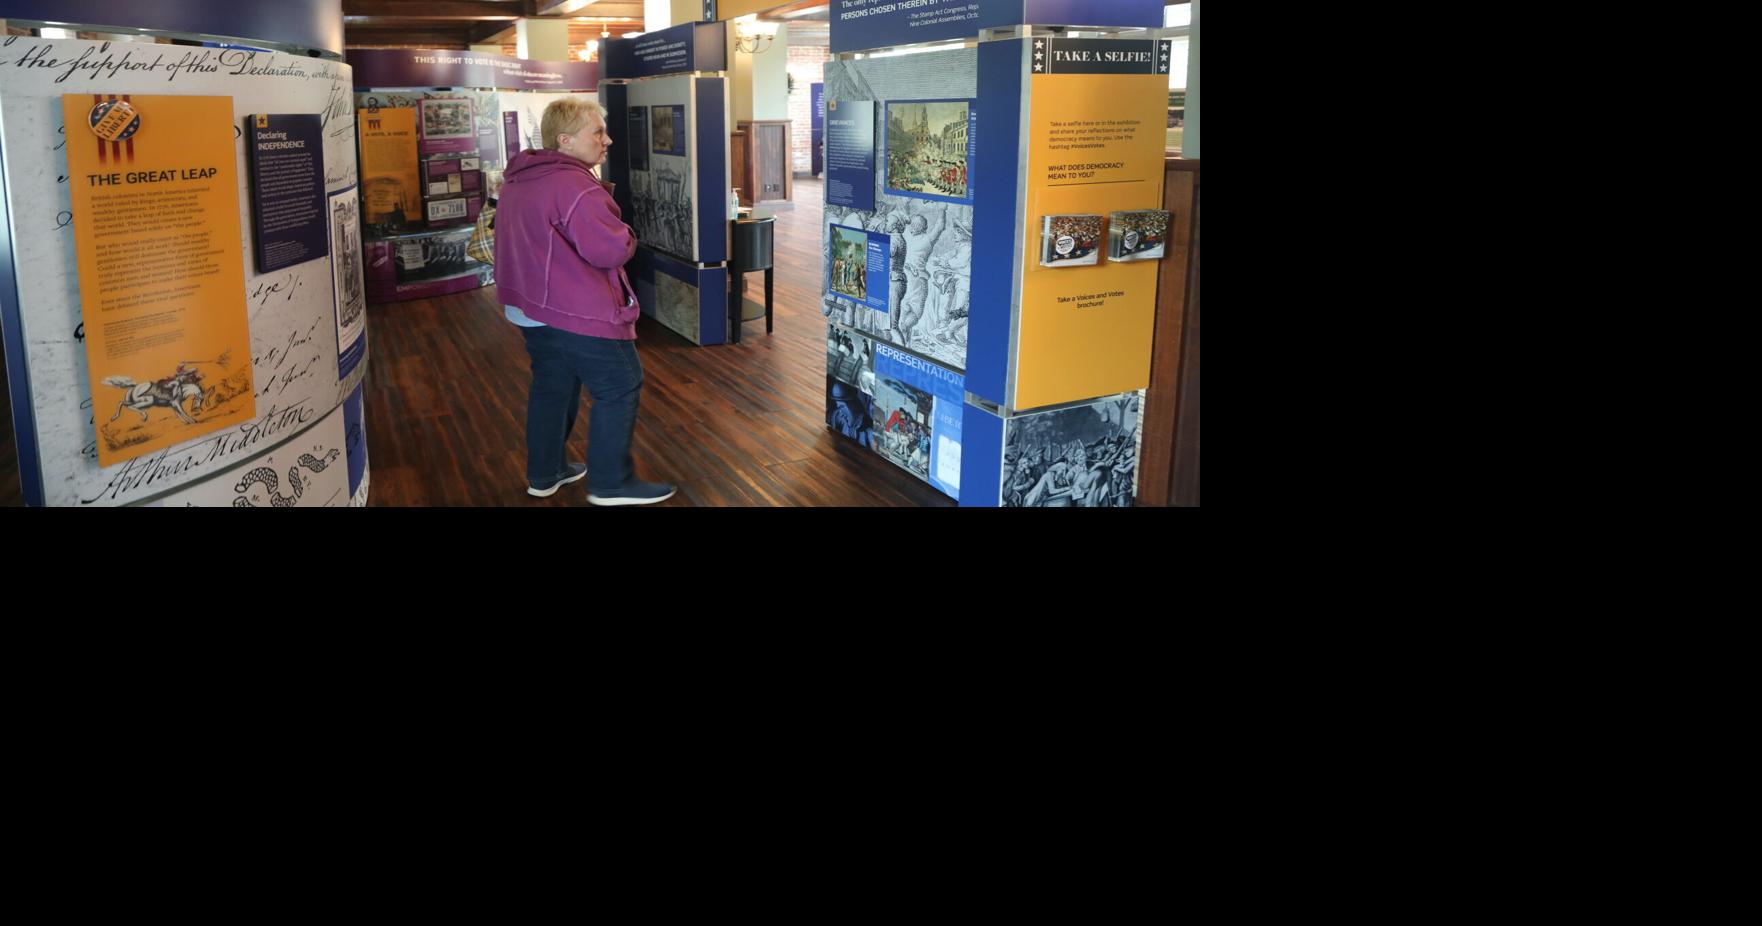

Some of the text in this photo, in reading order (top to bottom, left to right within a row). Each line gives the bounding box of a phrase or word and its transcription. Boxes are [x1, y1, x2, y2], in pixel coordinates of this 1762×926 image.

[841, 9, 868, 20] PERSONS
[869, 3, 896, 15] CHOSEN
[897, 0, 927, 10] THEREIN
[414, 56, 436, 64] THIS
[437, 56, 462, 64] RIGHT
[464, 57, 473, 65] TO
[1053, 50, 1151, 62] TAKE A SELFIE!
[257, 131, 287, 140] Declaring
[258, 140, 305, 150] INDEPENDENCE
[1086, 162, 1124, 170] DEMOCRACY
[87, 167, 217, 187] THE GREAT LEAP
[1077, 300, 1104, 308] brochure!
[876, 343, 963, 388] REPRESENTATION
